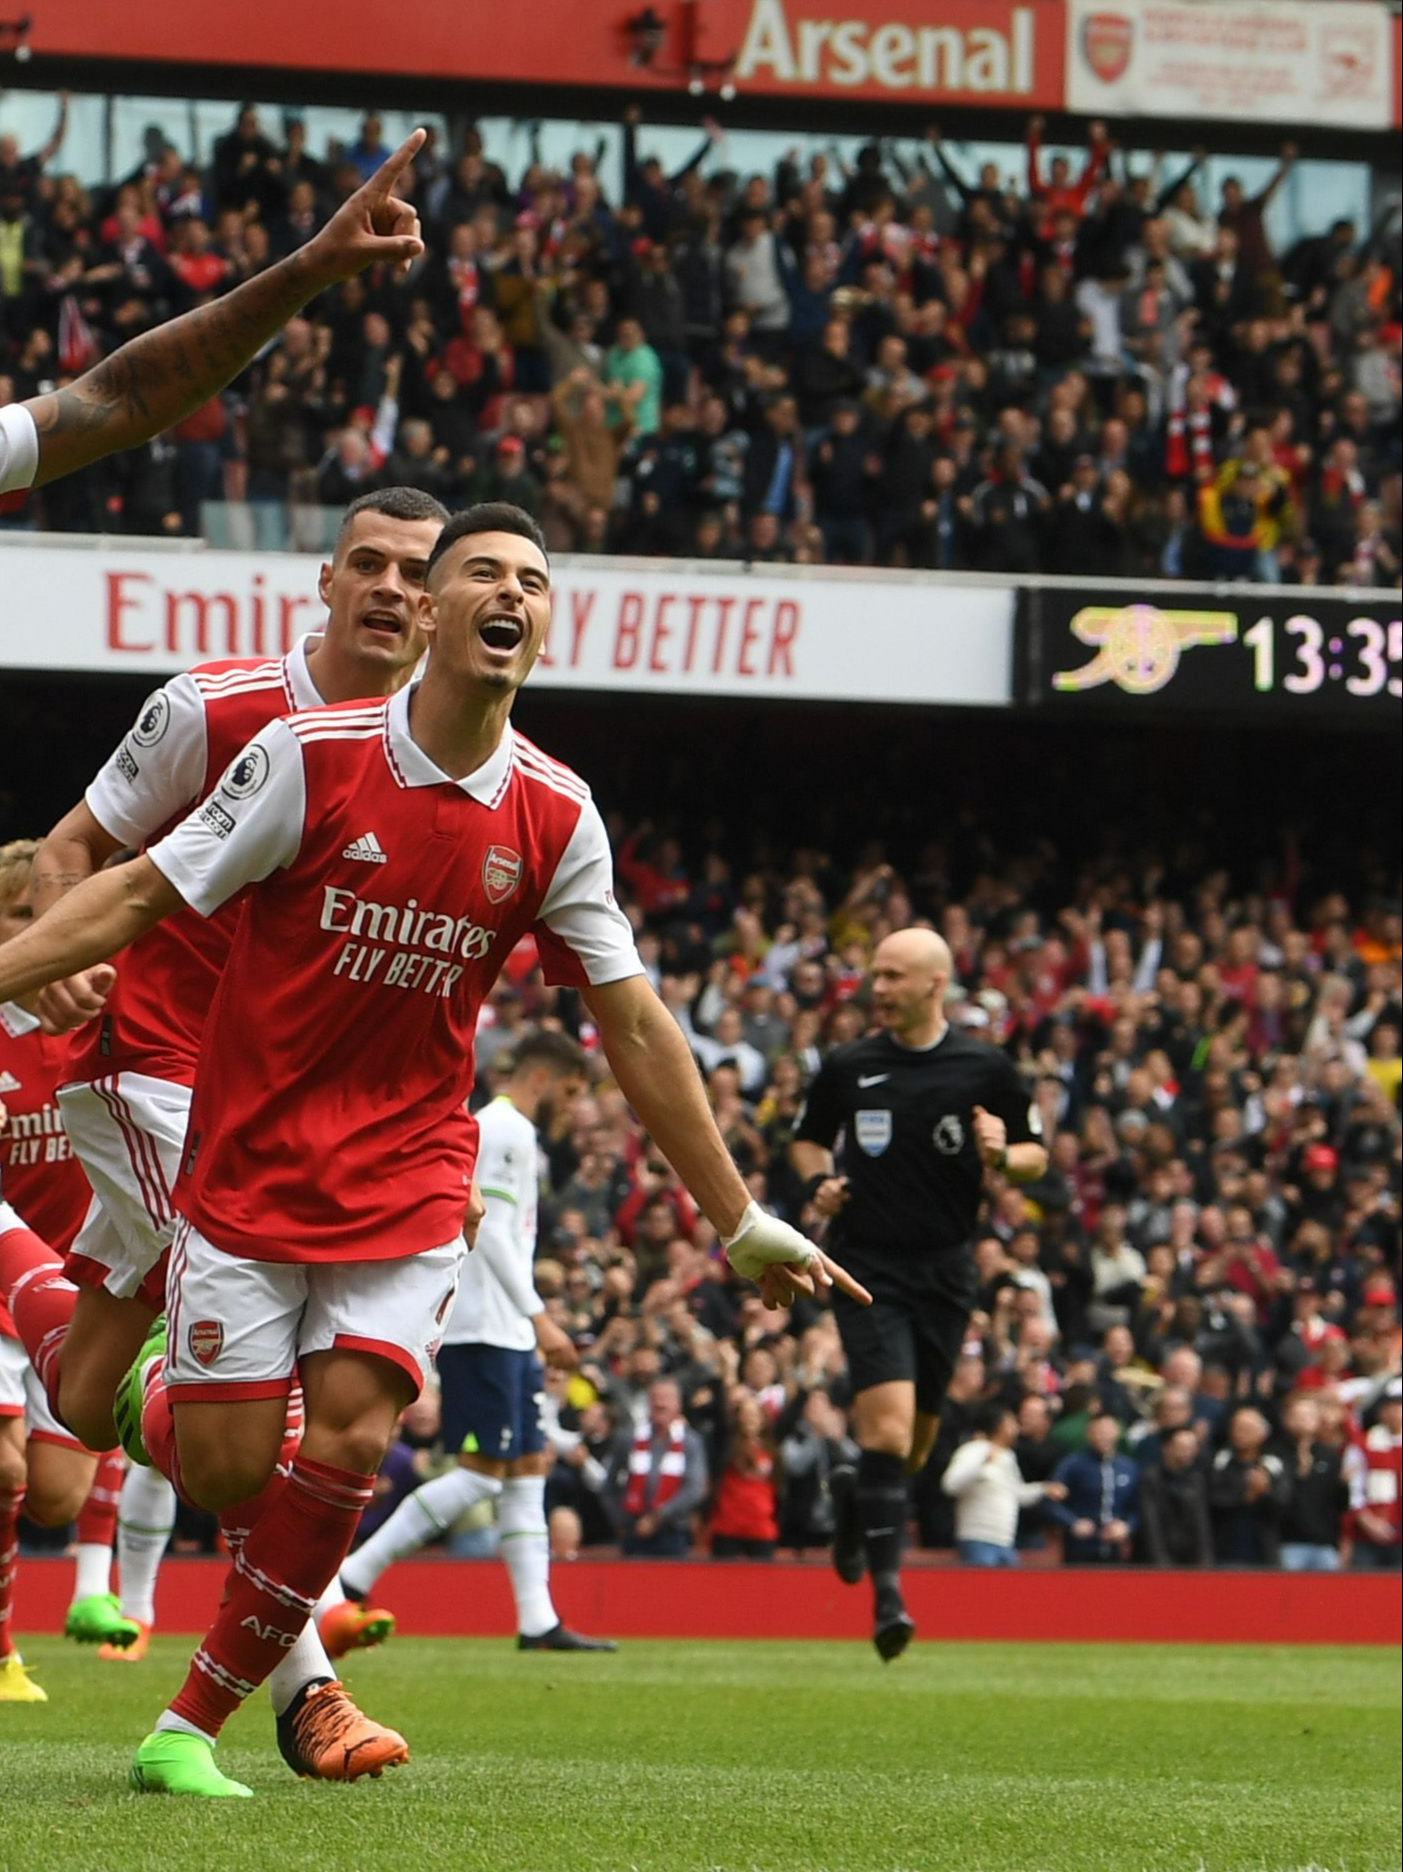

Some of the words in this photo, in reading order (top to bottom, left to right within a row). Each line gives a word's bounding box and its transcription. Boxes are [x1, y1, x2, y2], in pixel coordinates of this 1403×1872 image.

[735, 0, 1035, 94] Arsenal
[104, 571, 318, 655] Emir
[538, 592, 595, 668] LY
[611, 593, 801, 677] BETTER
[342, 849, 387, 863] adidas
[320, 885, 496, 959] Emirates
[333, 943, 386, 982] FLY
[383, 952, 463, 998] BETTR
[9, 1138, 42, 1165] FLY
[241, 1615, 298, 1648] AFC
